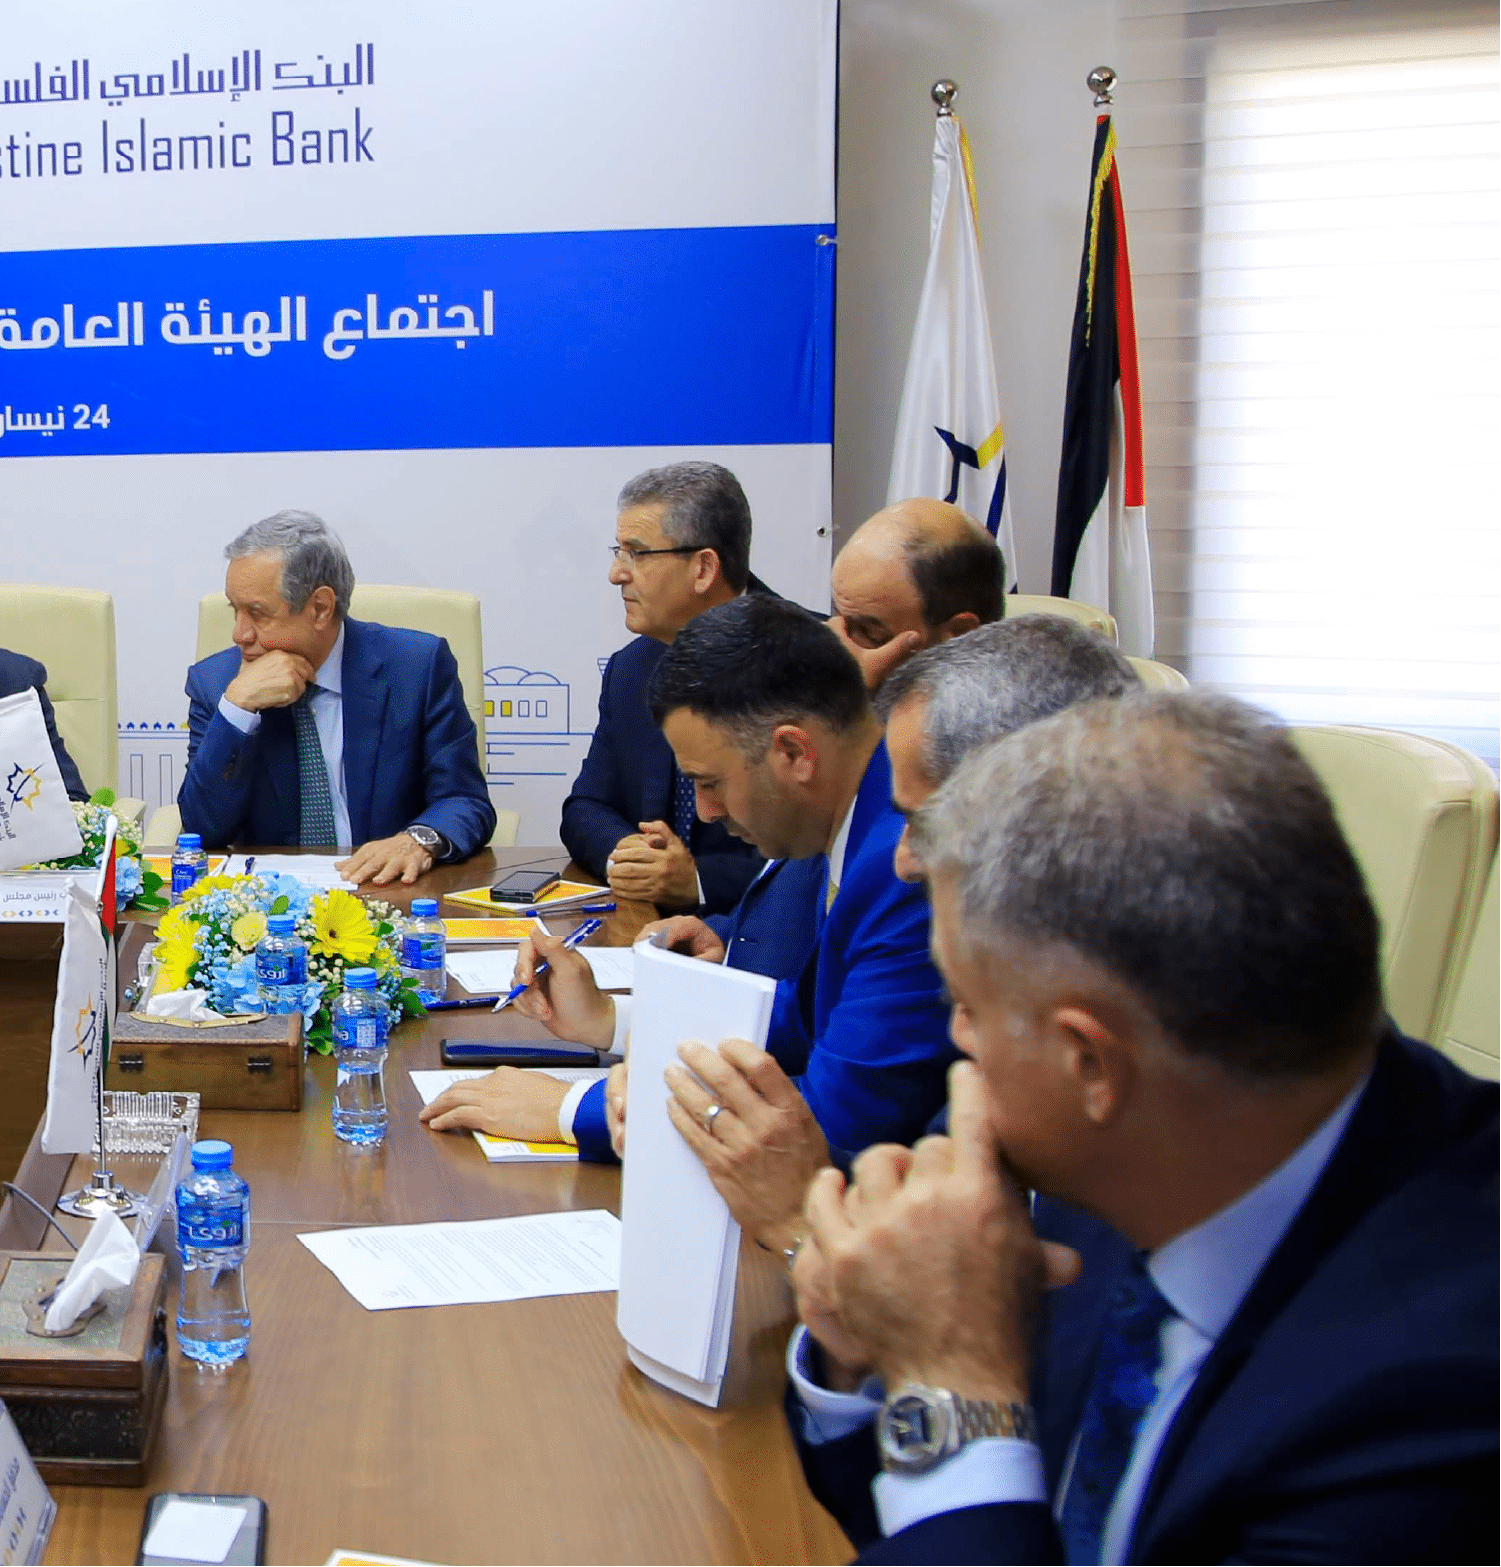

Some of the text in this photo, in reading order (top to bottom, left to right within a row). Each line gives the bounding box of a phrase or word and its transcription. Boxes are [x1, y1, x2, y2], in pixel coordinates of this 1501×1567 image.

[100, 48, 261, 106] الإسلامي
[273, 42, 374, 95] البنك
[102, 117, 252, 174] Islamic
[272, 106, 375, 166] Bank
[160, 295, 307, 358] الهيئة
[323, 290, 495, 361] اجتماع
[72, 403, 111, 431] 24
[2, 891, 32, 903] مجلس
[33, 890, 57, 902] رئيس
